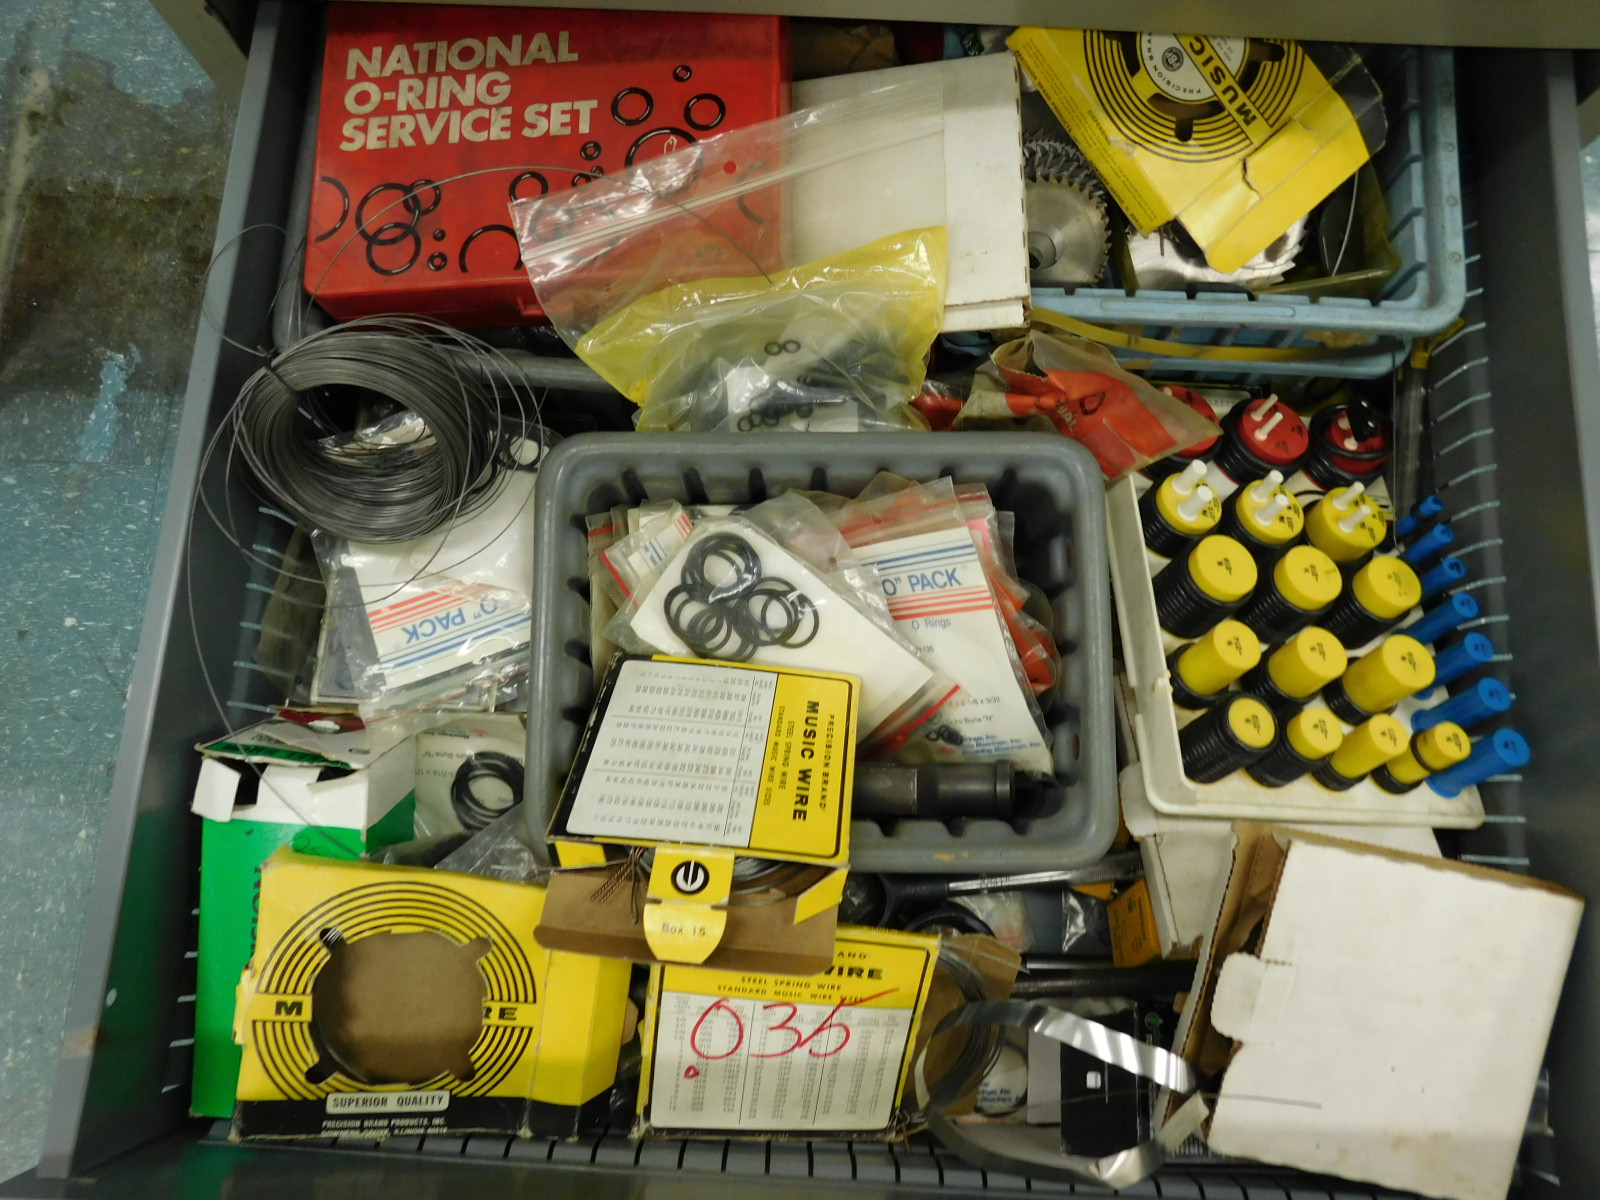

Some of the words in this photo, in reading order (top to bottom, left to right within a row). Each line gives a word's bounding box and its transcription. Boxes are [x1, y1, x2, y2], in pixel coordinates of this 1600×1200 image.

[346, 30, 579, 80] NATIONAL
[1152, 64, 1201, 94] PRECISION
[1189, 36, 1257, 127] MUSIC
[344, 71, 512, 115] O-RING
[339, 106, 513, 152] SERVICE
[522, 99, 598, 138] SET
[906, 567, 962, 593] PACK
[401, 607, 466, 645] PACK
[911, 620, 920, 631] O
[924, 618, 952, 629] Rings
[775, 705, 786, 738] STANDARD
[786, 720, 795, 739] STEEL
[801, 700, 820, 760] MUSIC
[770, 741, 780, 762] MUSIC
[782, 741, 792, 768] SPRING
[823, 714, 835, 768] PRECISION
[767, 766, 776, 783] WIRE
[779, 770, 788, 790] WIRE
[792, 767, 813, 822] WIRE
[819, 771, 829, 810] BRAND
[661, 922, 684, 936] Box
[690, 925, 706, 937] 15
[837, 950, 867, 960] AND
[717, 984, 768, 996] STANDARD
[773, 989, 804, 999] MUSIC
[809, 992, 833, 1001] WIRE
[741, 976, 768, 986] STEEL
[773, 979, 811, 990] SPRING
[817, 982, 843, 992] WIRE
[332, 1095, 388, 1108] SUPERIOR
[396, 1094, 444, 1107] QUALITY
